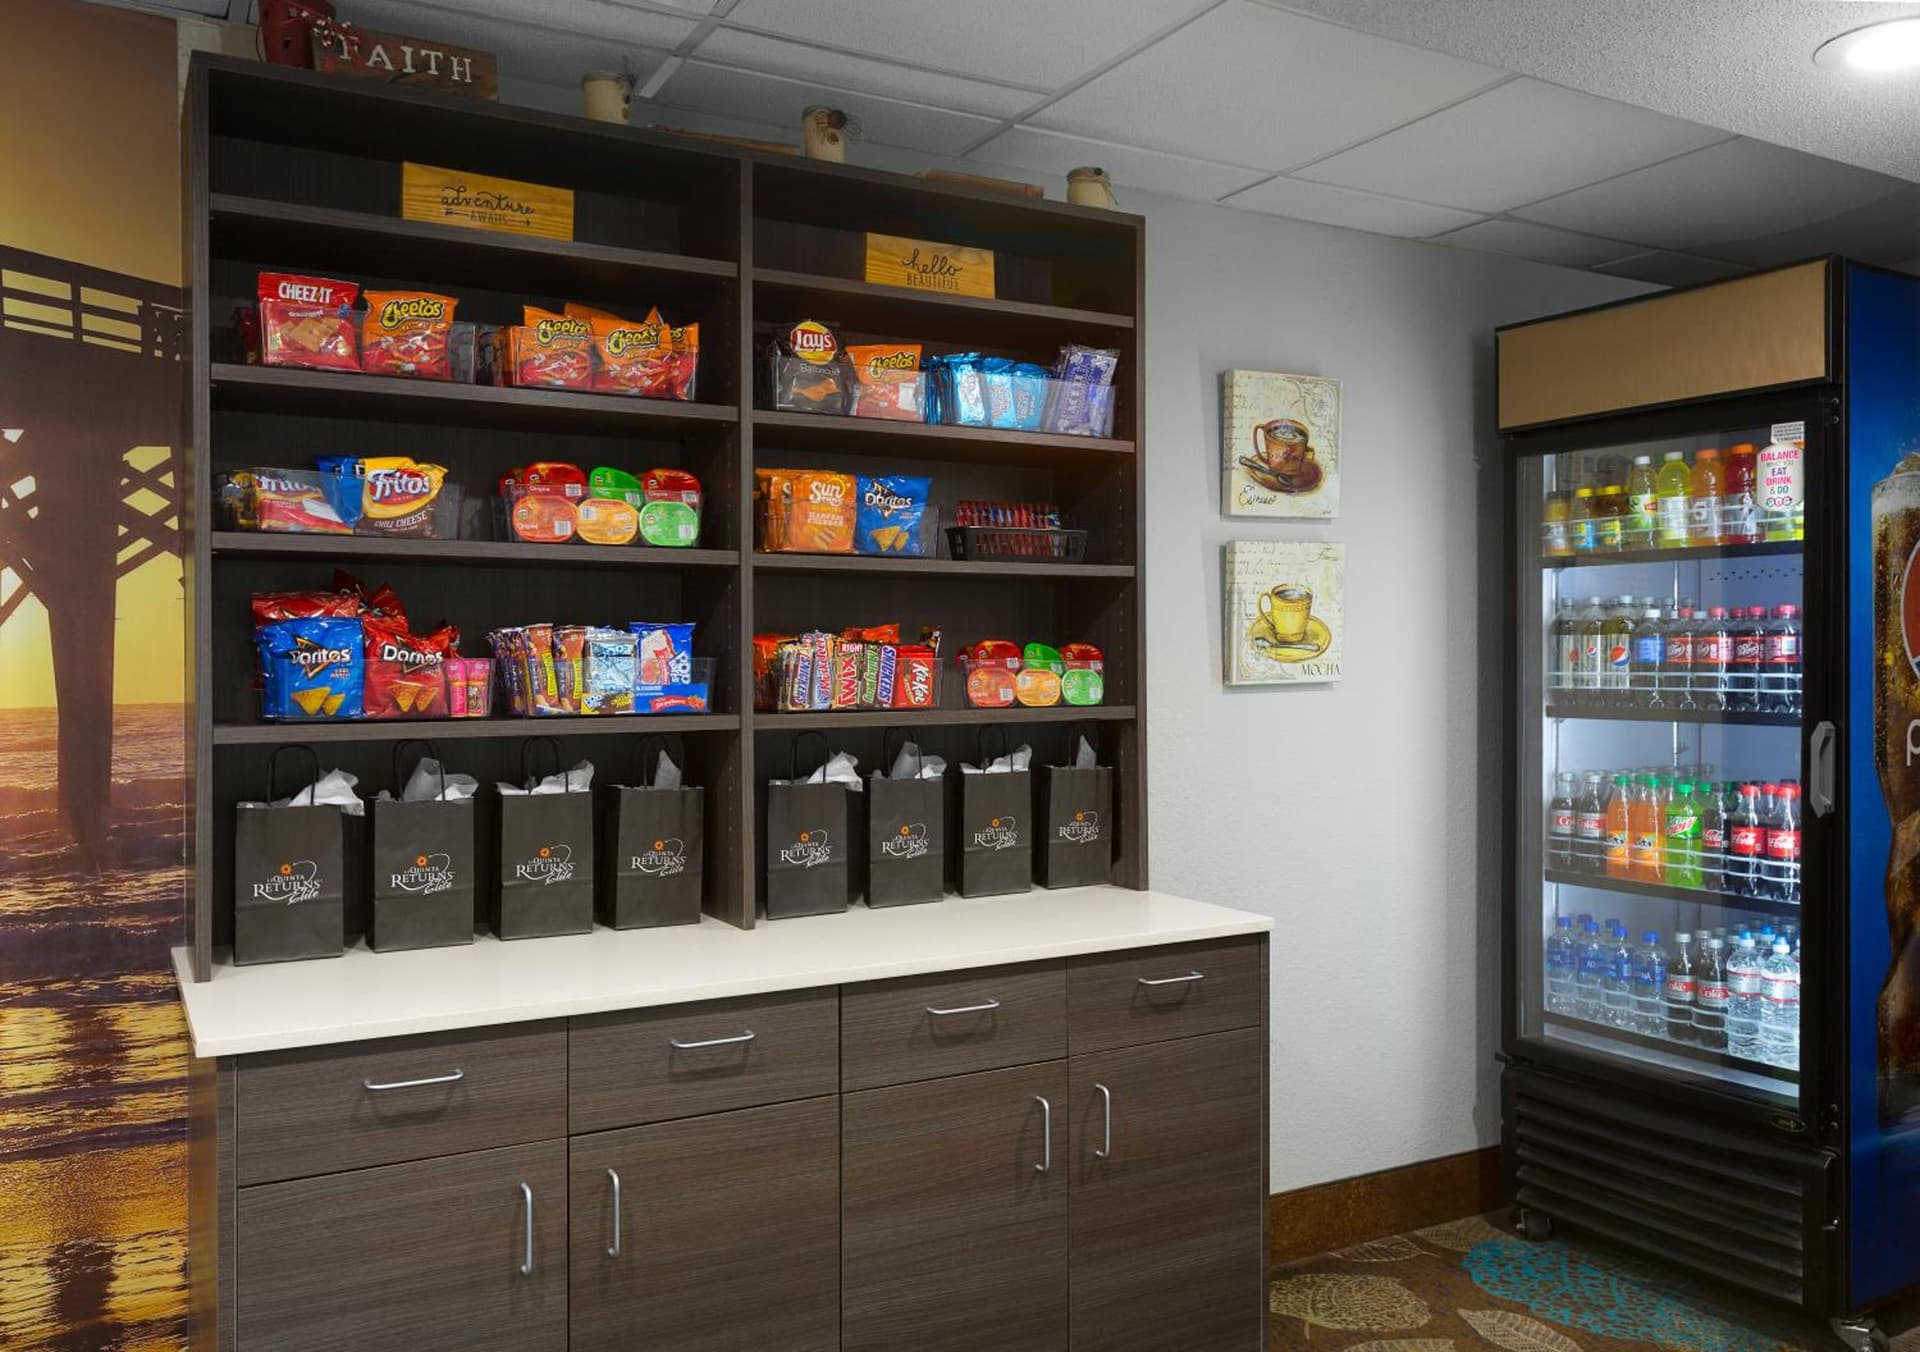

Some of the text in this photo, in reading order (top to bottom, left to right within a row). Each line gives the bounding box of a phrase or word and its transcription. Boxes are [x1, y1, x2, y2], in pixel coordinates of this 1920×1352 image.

[336, 33, 472, 82] FAITH
[441, 185, 536, 215] adventure
[902, 247, 963, 277] hello
[381, 298, 444, 330] Cheetos
[869, 353, 915, 379] Cheetos
[1760, 450, 1800, 462] BALANCE
[1771, 467, 1787, 476] EAT
[367, 468, 430, 502] Fritos
[1765, 476, 1792, 486] DRINK
[1777, 485, 1789, 494] DO
[290, 646, 352, 666] Doritos
[879, 646, 896, 703] SNICKERS
[1301, 664, 1341, 675] MOCHA
[837, 654, 857, 705] TWIX
[974, 831, 1018, 847] RETURNS
[1059, 826, 1099, 841] RETURNS
[781, 847, 831, 864] RETURNS
[882, 840, 928, 856] RETURNS
[516, 863, 573, 880] RETURNS
[632, 856, 686, 872] RETURNS
[273, 874, 305, 884] QUINTA
[391, 871, 454, 891] RETURNS
[423, 879, 454, 896] Elite
[253, 880, 320, 899] RETURNS
[288, 886, 319, 905] Elite
